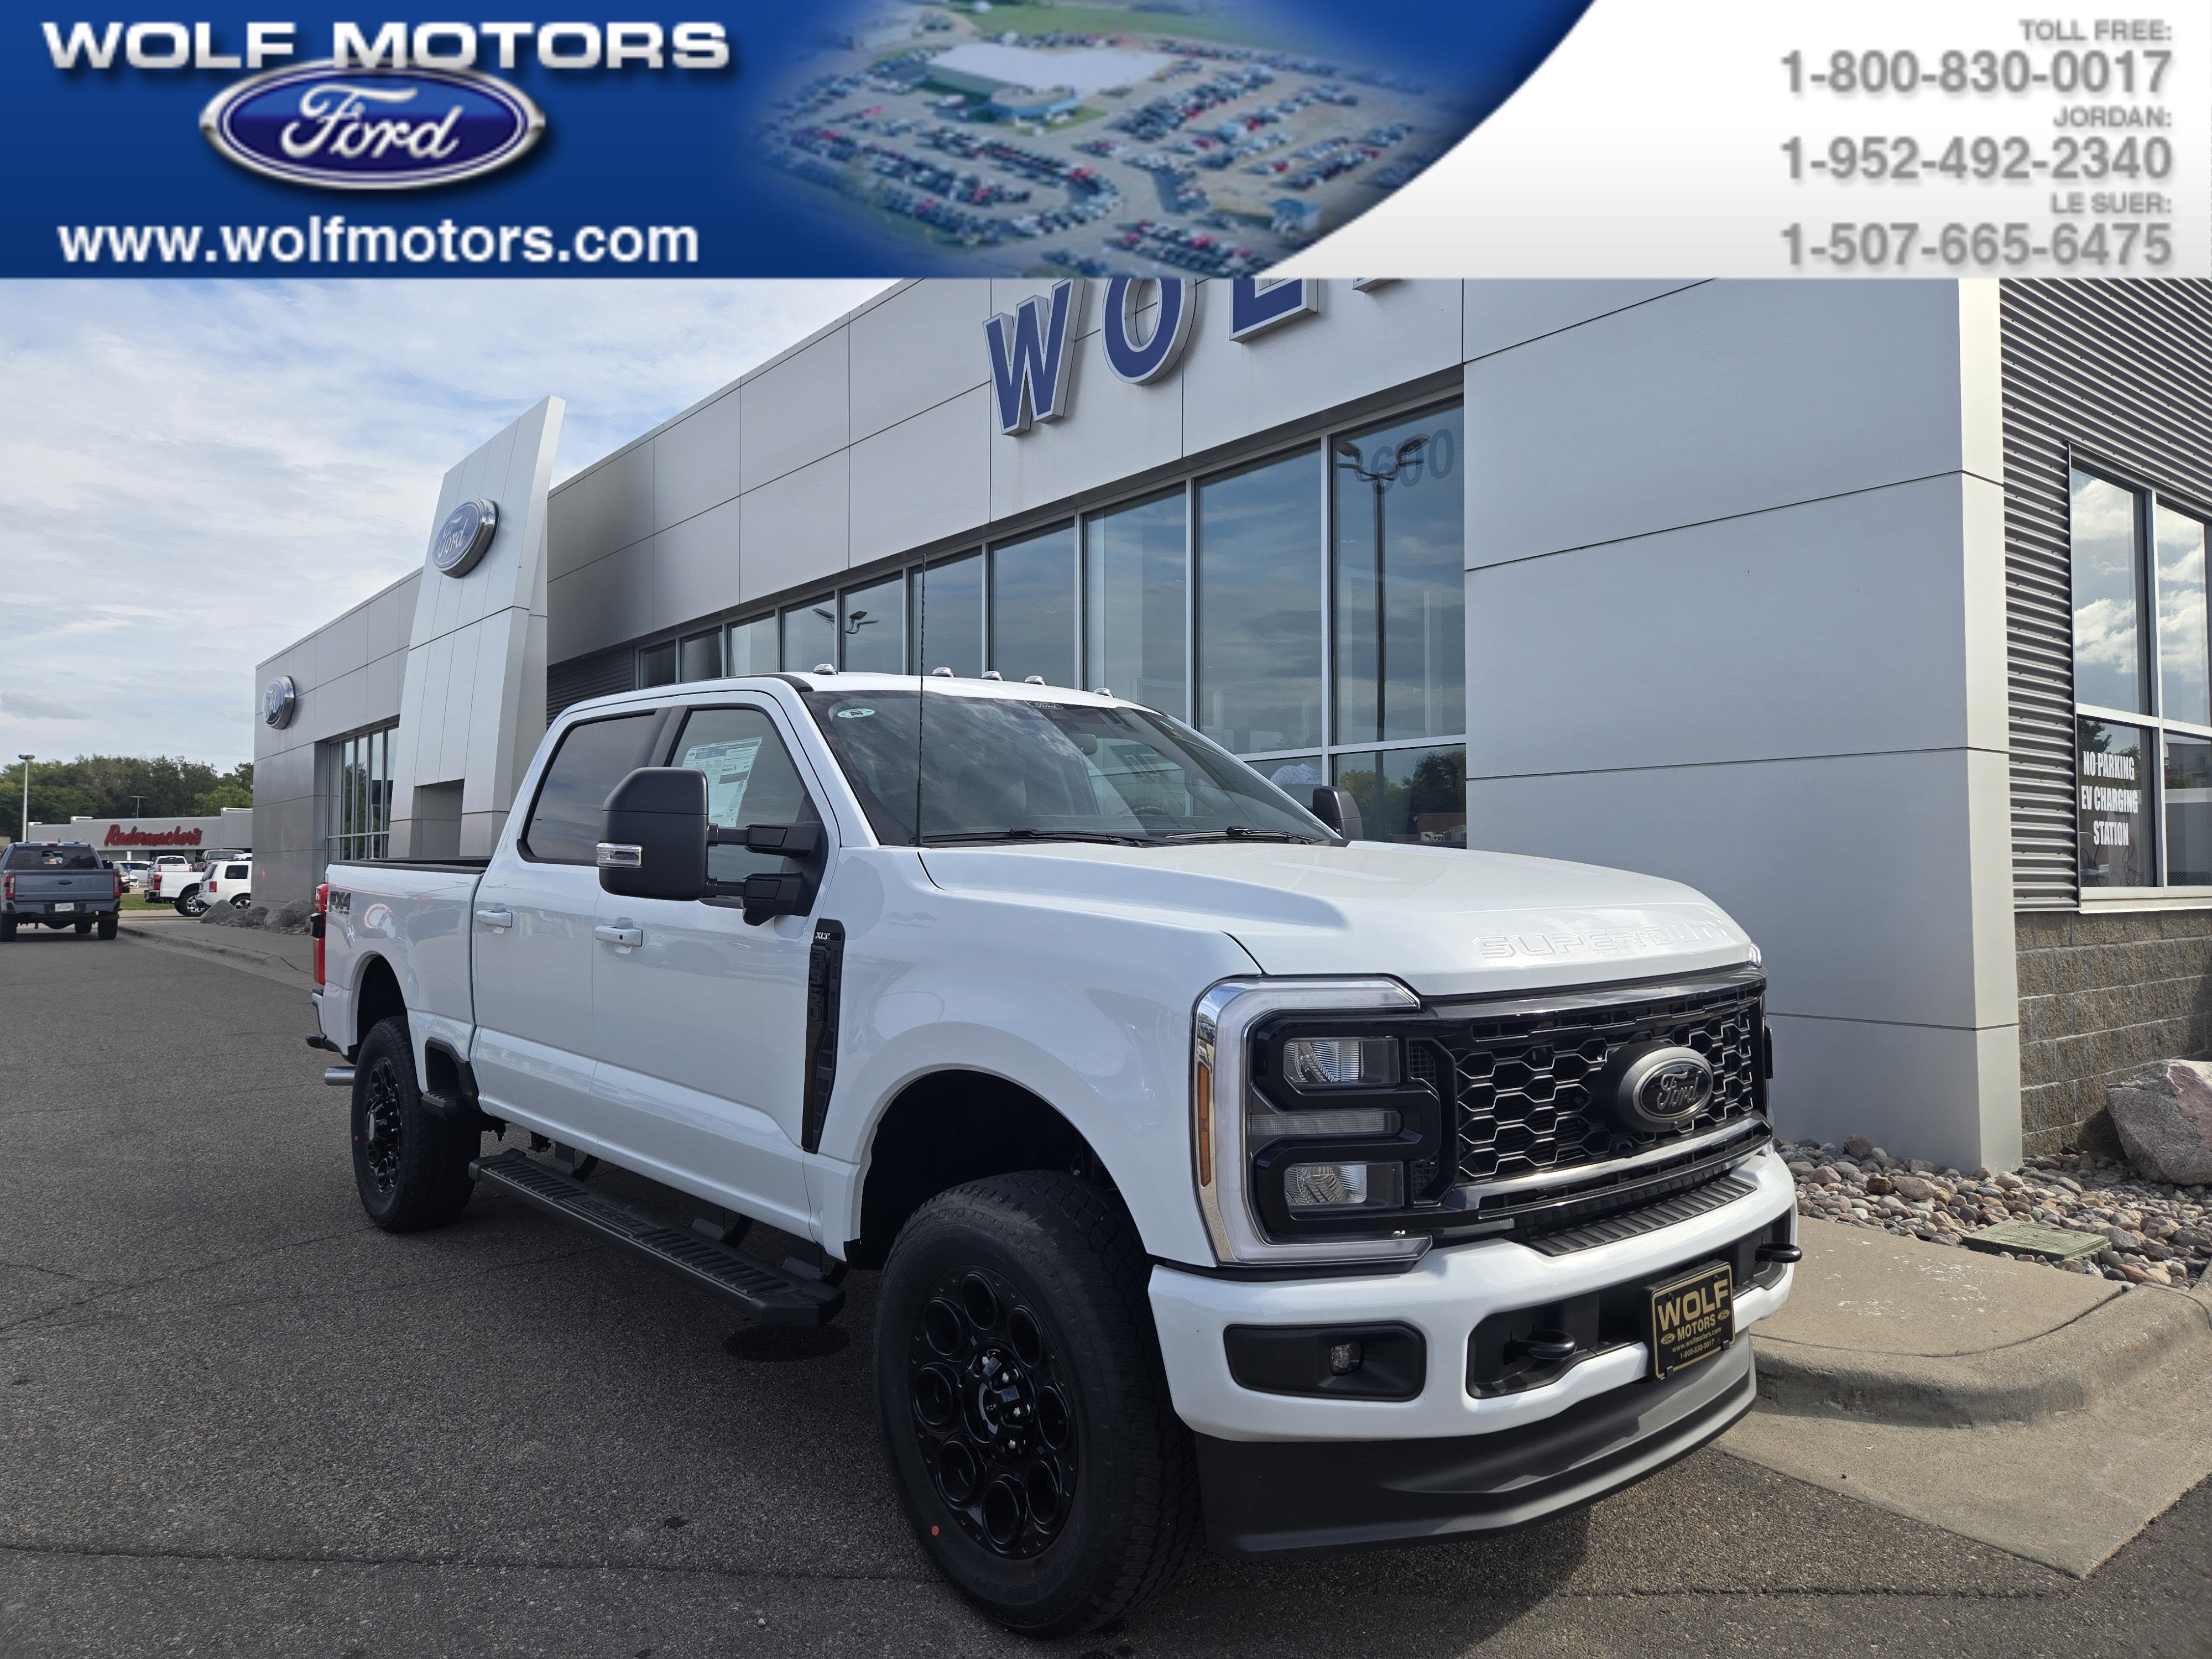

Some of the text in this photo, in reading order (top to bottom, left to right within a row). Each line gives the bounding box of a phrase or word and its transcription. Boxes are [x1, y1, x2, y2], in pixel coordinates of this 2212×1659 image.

[1370, 429, 1454, 495] 600
[438, 514, 469, 560] Ford
[2083, 750, 2135, 780] NO PARKING
[2081, 785, 2138, 813] EV CHARGING
[2093, 820, 2129, 846] STATION
[328, 891, 351, 912] FX4
[815, 931, 831, 940] XLT
[1657, 1071, 1703, 1110] Ford
[1657, 1279, 1729, 1332] WOLF
[1672, 1327, 1721, 1353] www.wolfmotors.com
[1677, 1313, 1716, 1341] MOTORS
